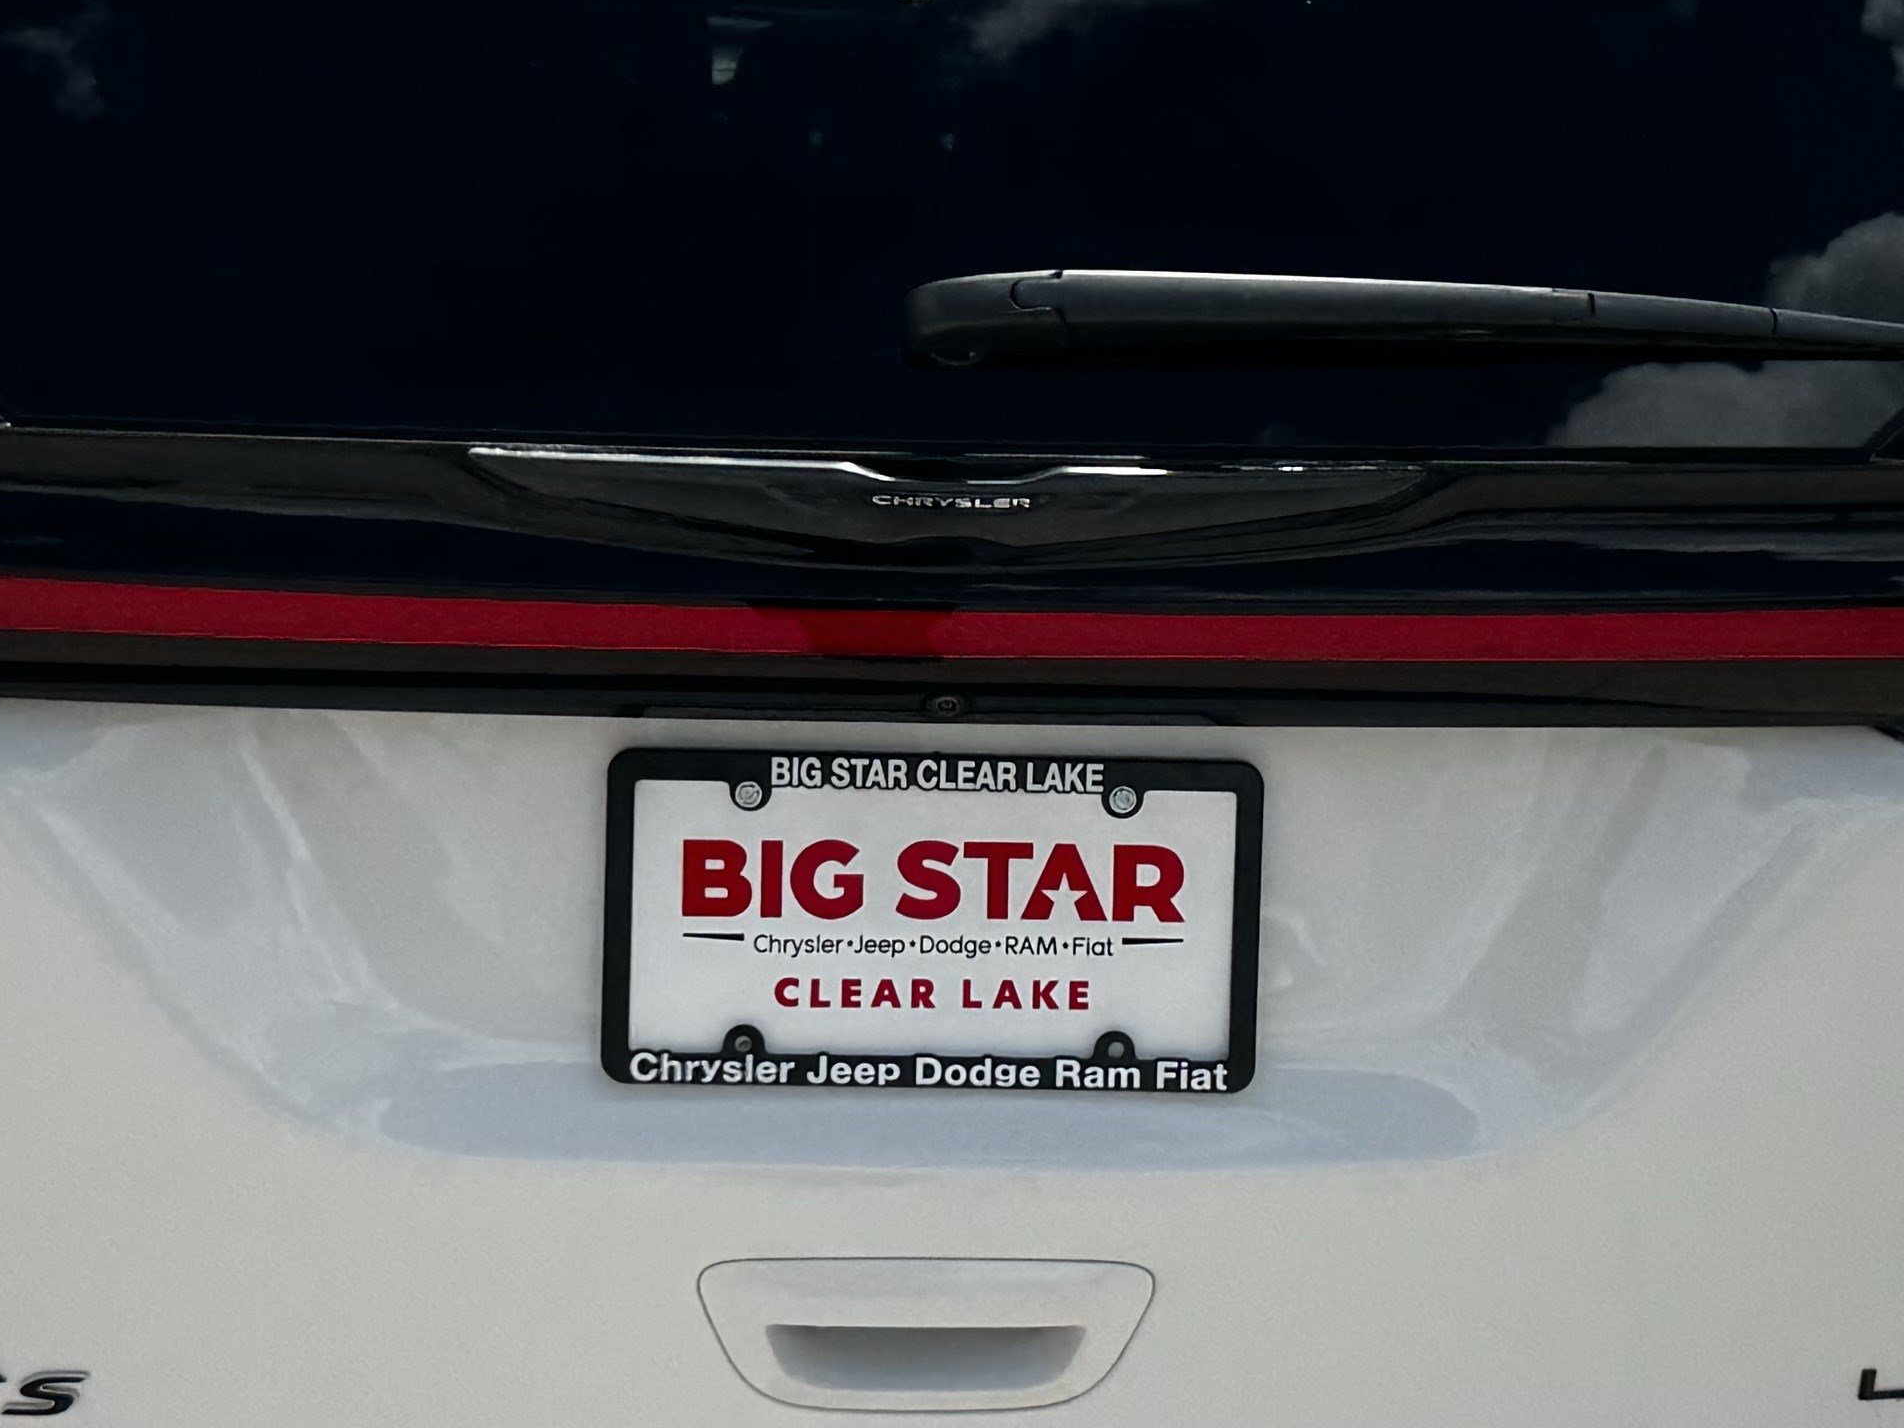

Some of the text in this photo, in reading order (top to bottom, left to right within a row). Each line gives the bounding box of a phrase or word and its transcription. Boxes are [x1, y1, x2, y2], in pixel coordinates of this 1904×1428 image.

[871, 494, 1031, 509] CHRYSLER
[770, 756, 1105, 794] BIG STAR CLEAR LAKE
[682, 839, 1185, 923] BIG STAR
[774, 977, 1090, 1010] CLEAR LAKE
[630, 1051, 1228, 1091] Chrysler Jeep Dodge Ram Fiat
[0, 1371, 91, 1416] S
